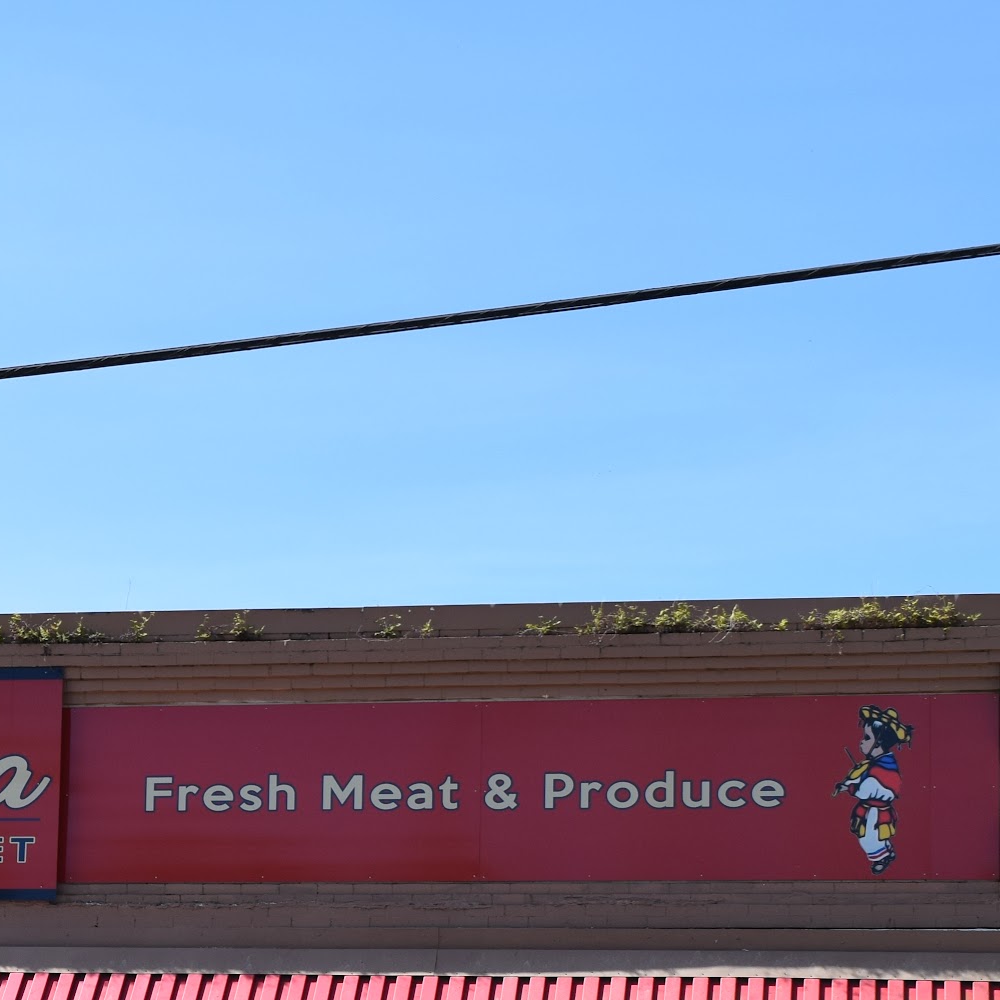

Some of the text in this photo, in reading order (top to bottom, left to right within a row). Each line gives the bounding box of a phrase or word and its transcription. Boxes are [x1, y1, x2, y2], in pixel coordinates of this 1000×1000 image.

[143, 770, 786, 814] Fresh Meat & Produce
